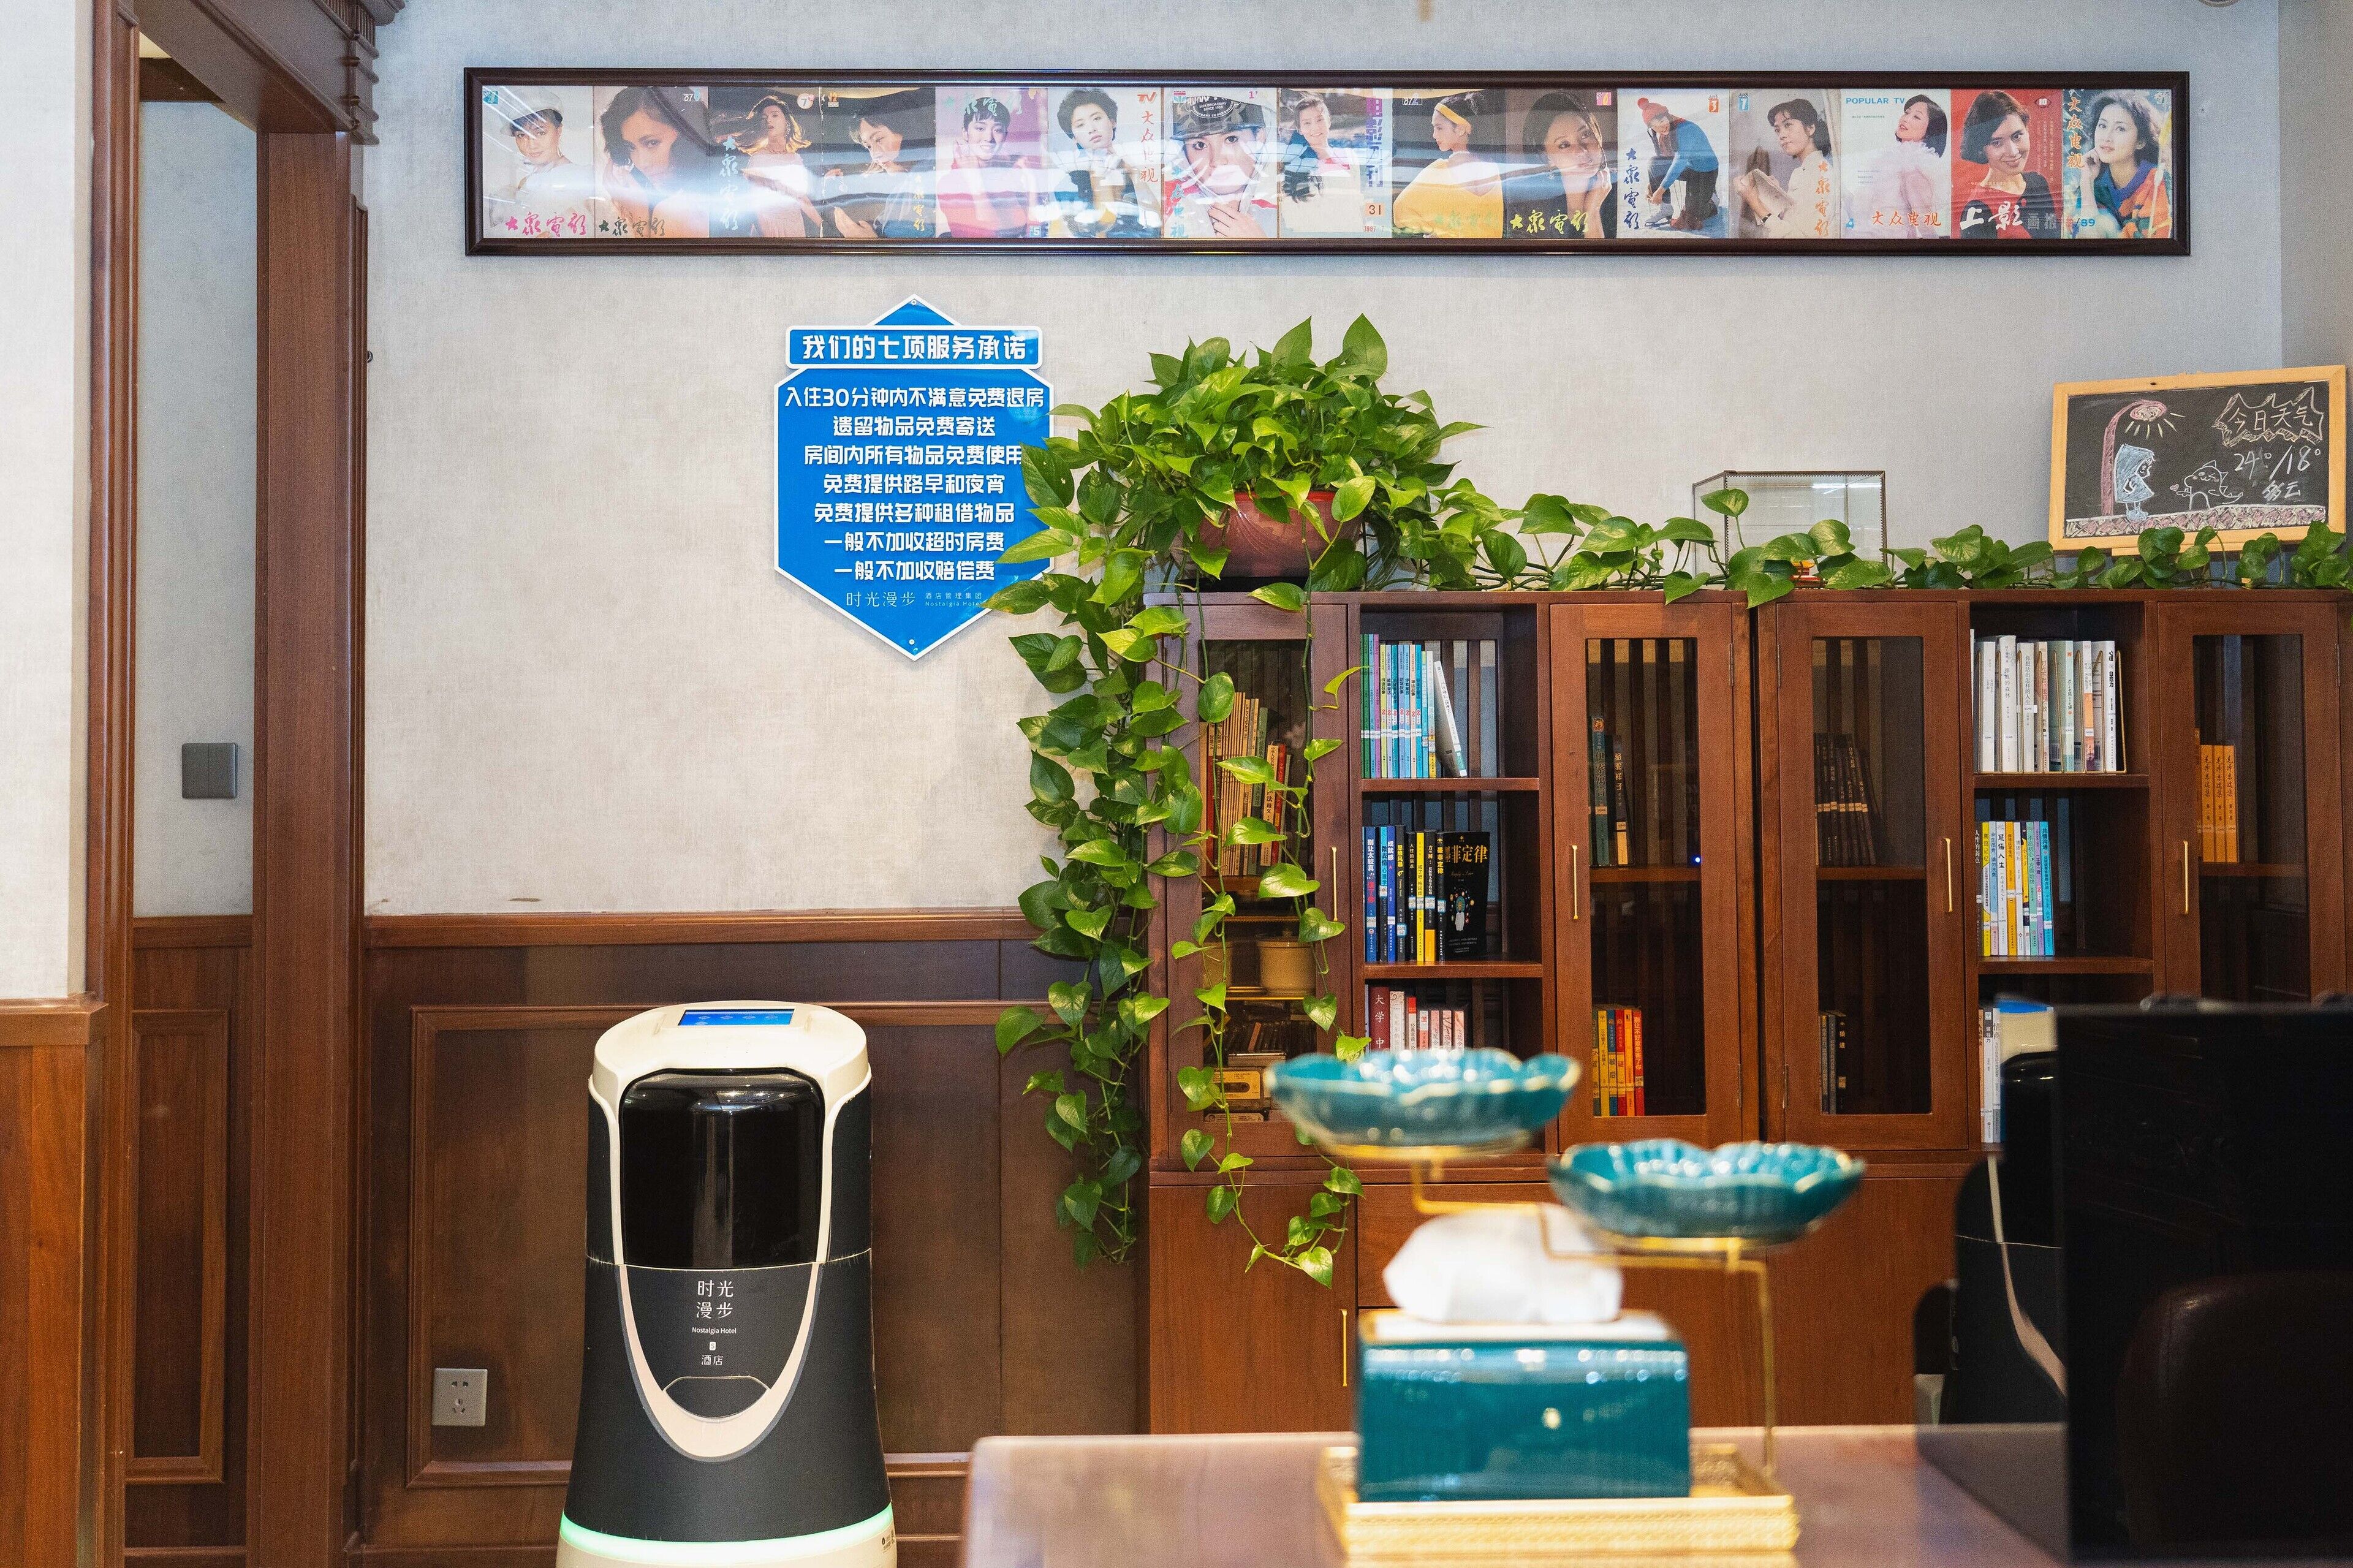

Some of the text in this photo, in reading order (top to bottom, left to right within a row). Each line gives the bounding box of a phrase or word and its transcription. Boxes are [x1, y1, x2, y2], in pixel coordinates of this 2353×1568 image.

[1138, 92, 1156, 103] TV
[1369, 205, 1381, 215] 31
[1872, 210, 1941, 227] 大众电视
[802, 335, 1026, 360] 我们的七项服务承诺
[785, 387, 1044, 408] 入住30分钟内不满意免费退房
[833, 415, 996, 436] 遗留物品免费寄送
[2227, 406, 2313, 431] 今日天气
[804, 444, 1022, 466] 房间内所有物品免费使用
[824, 474, 1005, 494] 免费提供路早和夜宵
[2261, 480, 2302, 502] 多云
[814, 502, 1015, 523] 免费提供多种租借物品
[824, 531, 1005, 552] 一般不加收超时房费
[834, 560, 995, 581] 一般不加收赔偿费
[846, 591, 916, 607] 时光漫步
[697, 1279, 734, 1297] 时光
[696, 1301, 733, 1319] 漫步
[692, 1327, 719, 1335] Nostalgia
[701, 1354, 724, 1366] 酒店
